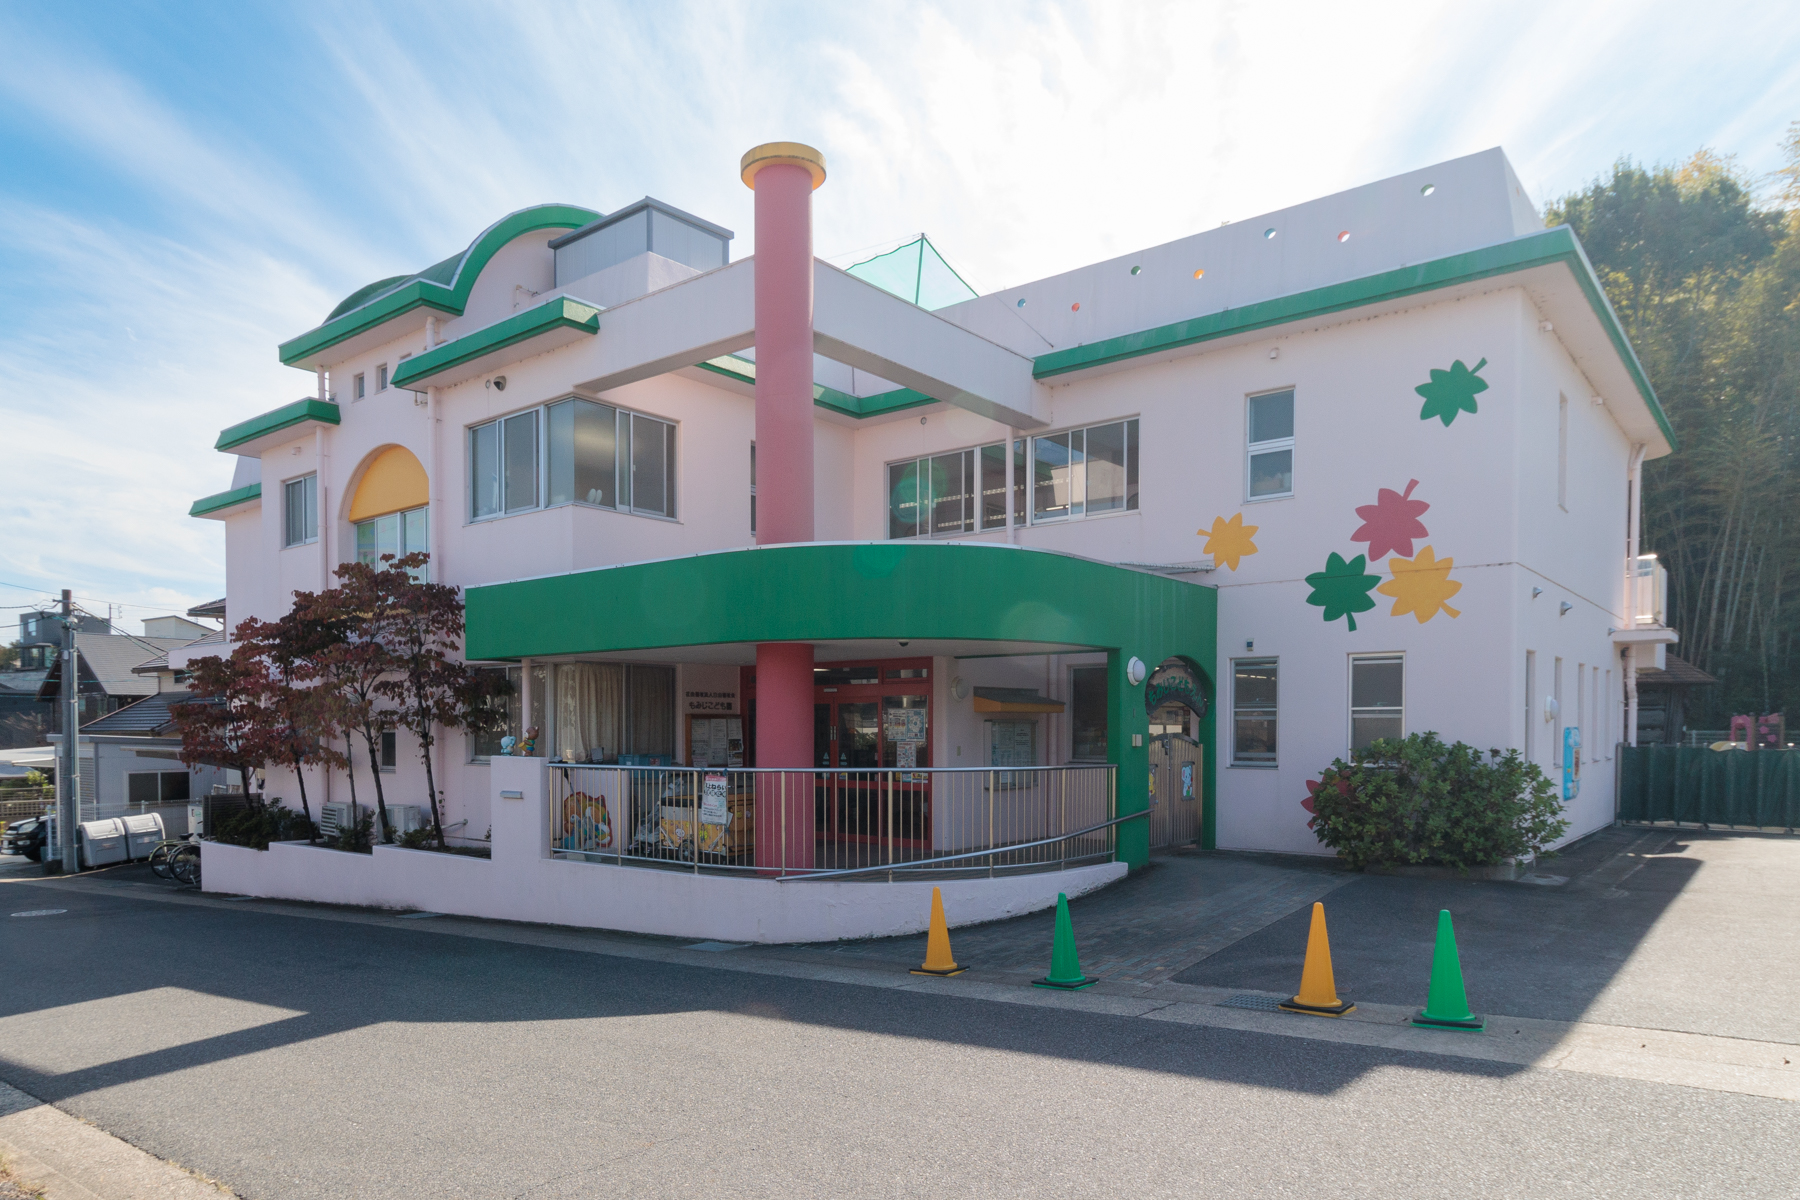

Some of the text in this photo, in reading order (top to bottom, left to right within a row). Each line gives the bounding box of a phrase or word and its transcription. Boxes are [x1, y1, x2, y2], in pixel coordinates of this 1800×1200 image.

[689, 702, 732, 710] もみじこども園
